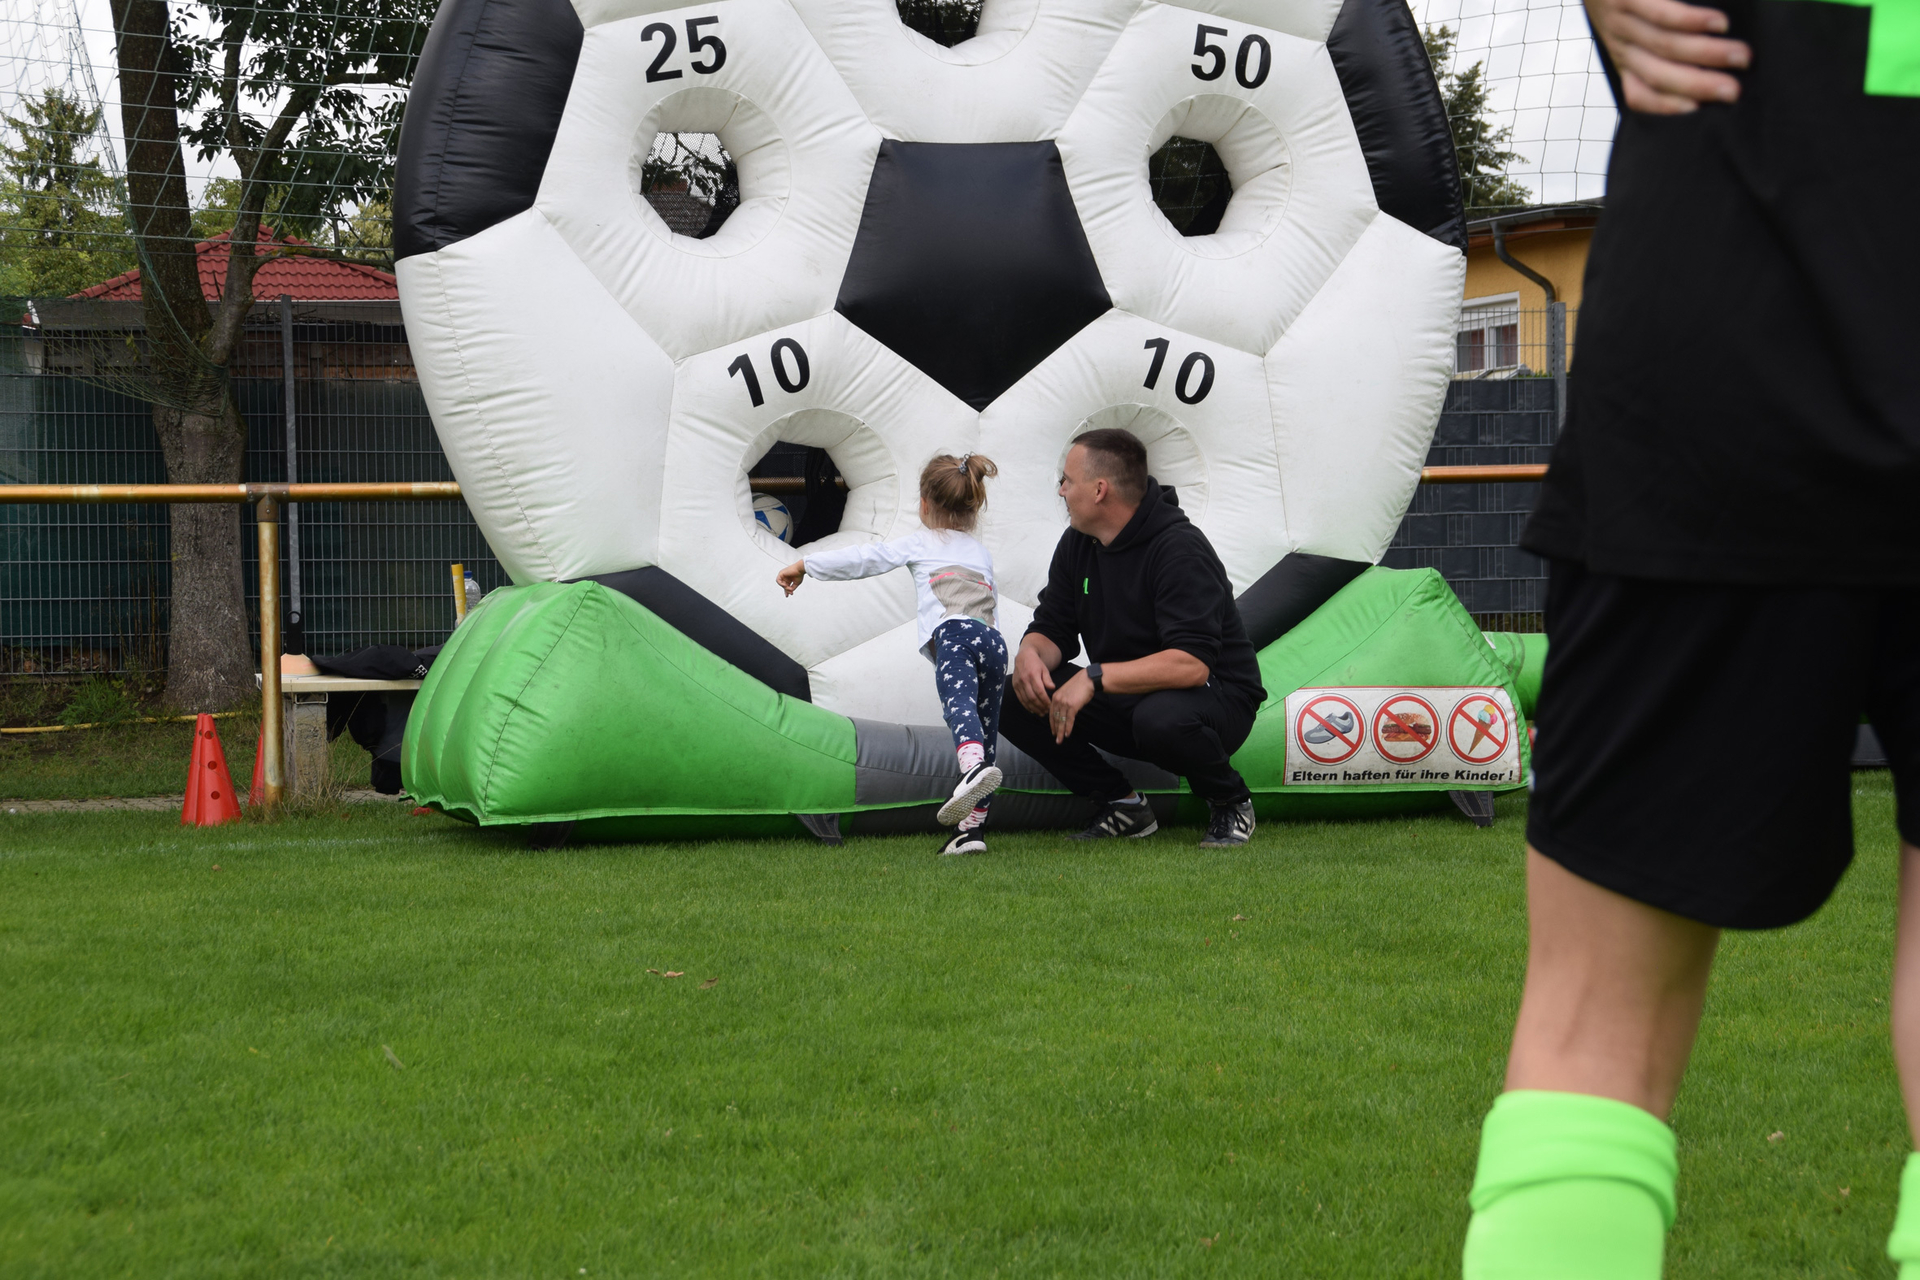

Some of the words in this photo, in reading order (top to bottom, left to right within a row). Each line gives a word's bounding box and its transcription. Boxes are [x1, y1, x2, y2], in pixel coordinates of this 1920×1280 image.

[640, 15, 727, 84] 25
[1191, 23, 1272, 90] 50
[727, 337, 811, 408] 10
[1142, 337, 1215, 405] 10
[1292, 770, 1338, 782] Eltern
[1342, 769, 1391, 782] haften
[1395, 769, 1418, 781] für
[1420, 769, 1450, 781] ihre
[1454, 769, 1505, 782] Kinder
